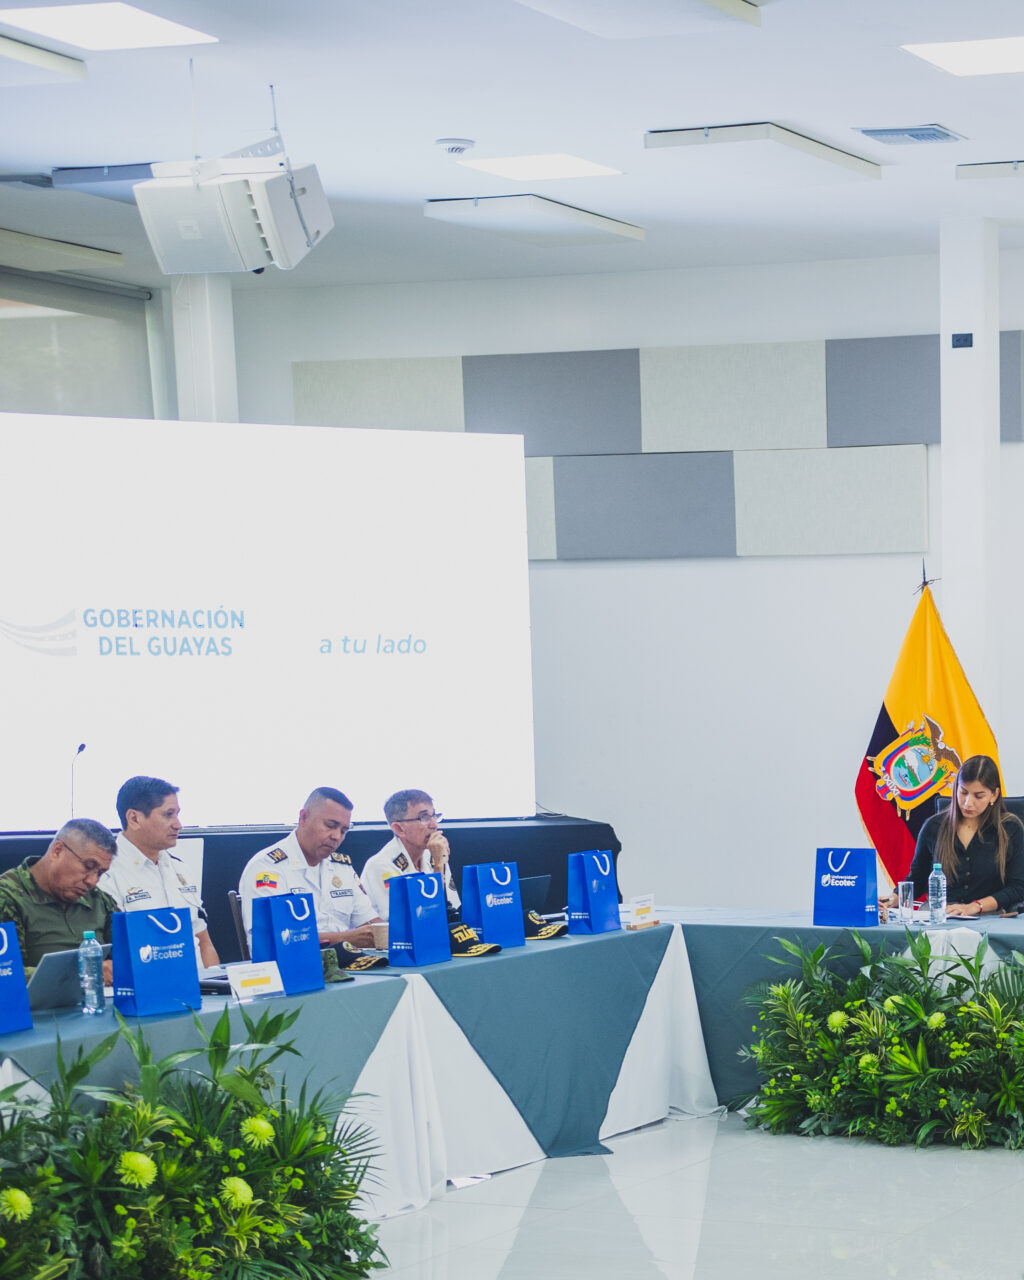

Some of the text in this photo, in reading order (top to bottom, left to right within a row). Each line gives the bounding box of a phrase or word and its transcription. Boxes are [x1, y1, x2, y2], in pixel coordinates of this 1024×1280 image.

[82, 604, 246, 629] GOBERNACIÓN
[98, 636, 233, 656] DEL GUAYAS
[319, 633, 427, 654] a tu lado
[153, 949, 183, 961] Ecotec
